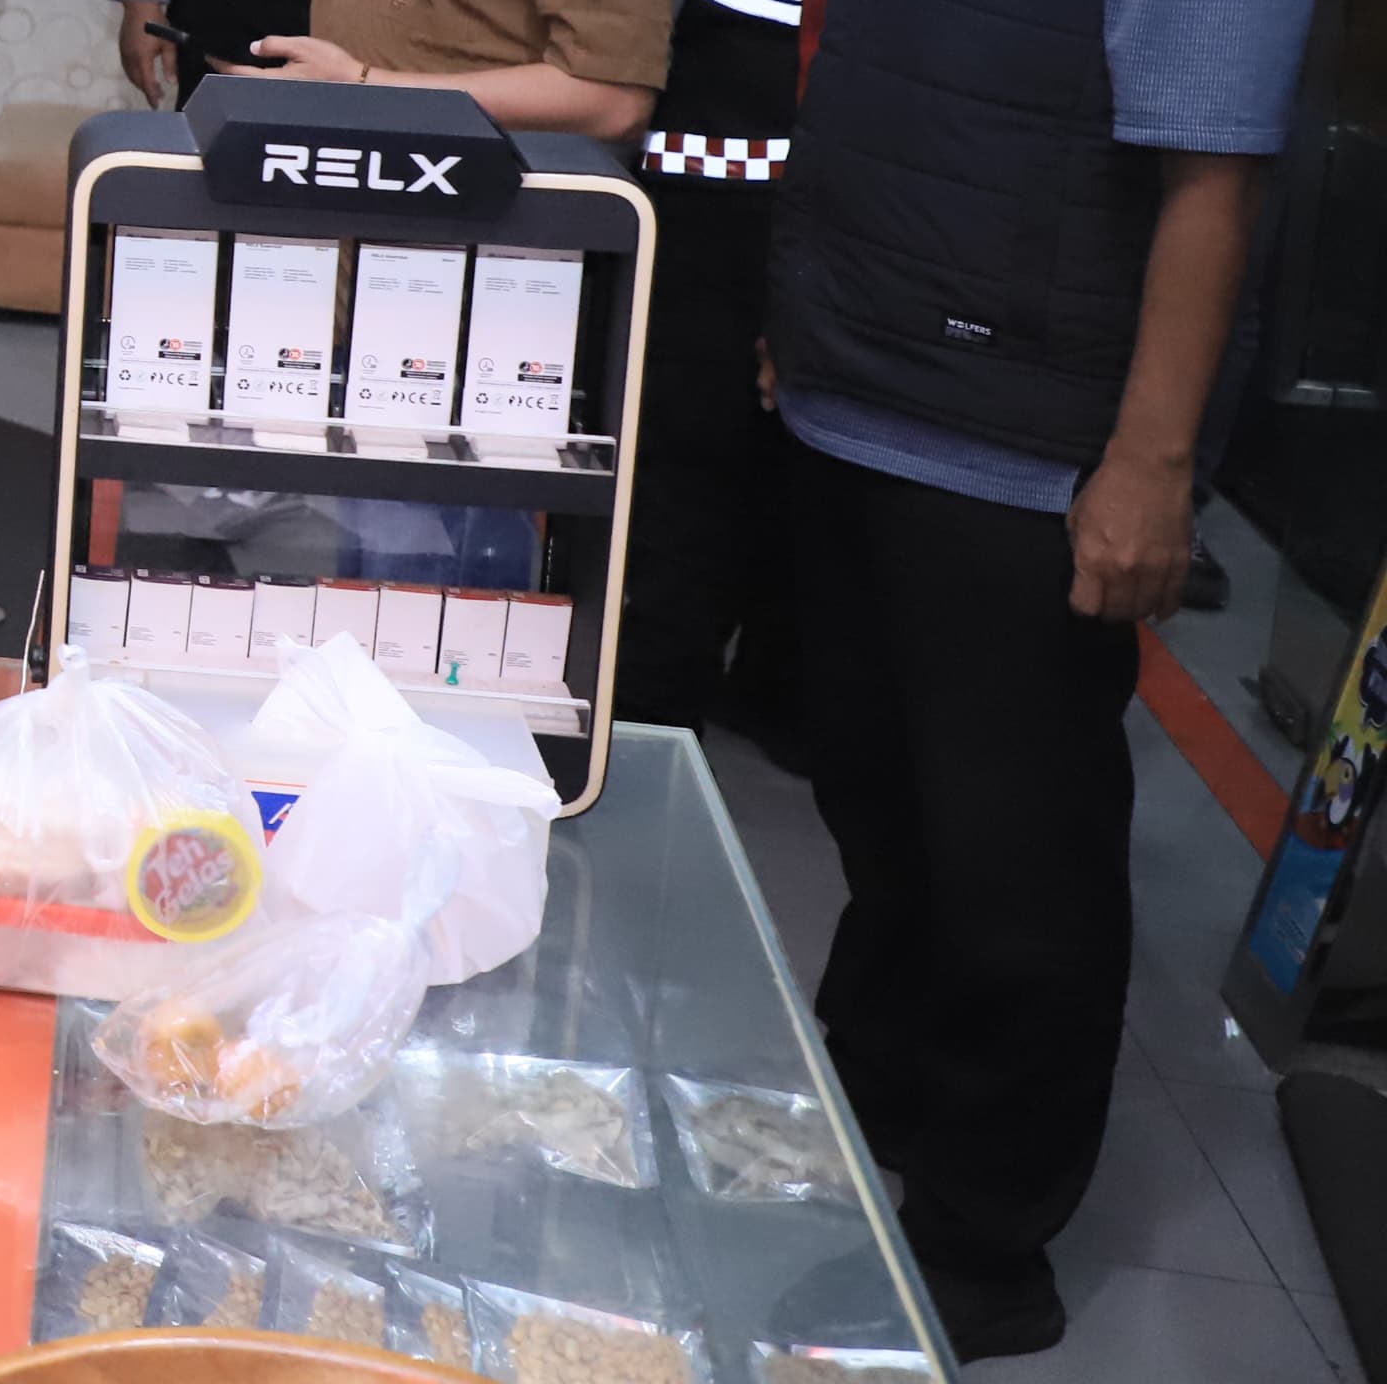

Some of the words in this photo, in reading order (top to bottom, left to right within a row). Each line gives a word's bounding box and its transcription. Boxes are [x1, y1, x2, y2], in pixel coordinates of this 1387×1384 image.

[261, 143, 463, 195] RELX
[146, 837, 205, 888] Teh
[156, 850, 235, 924] Gelas
